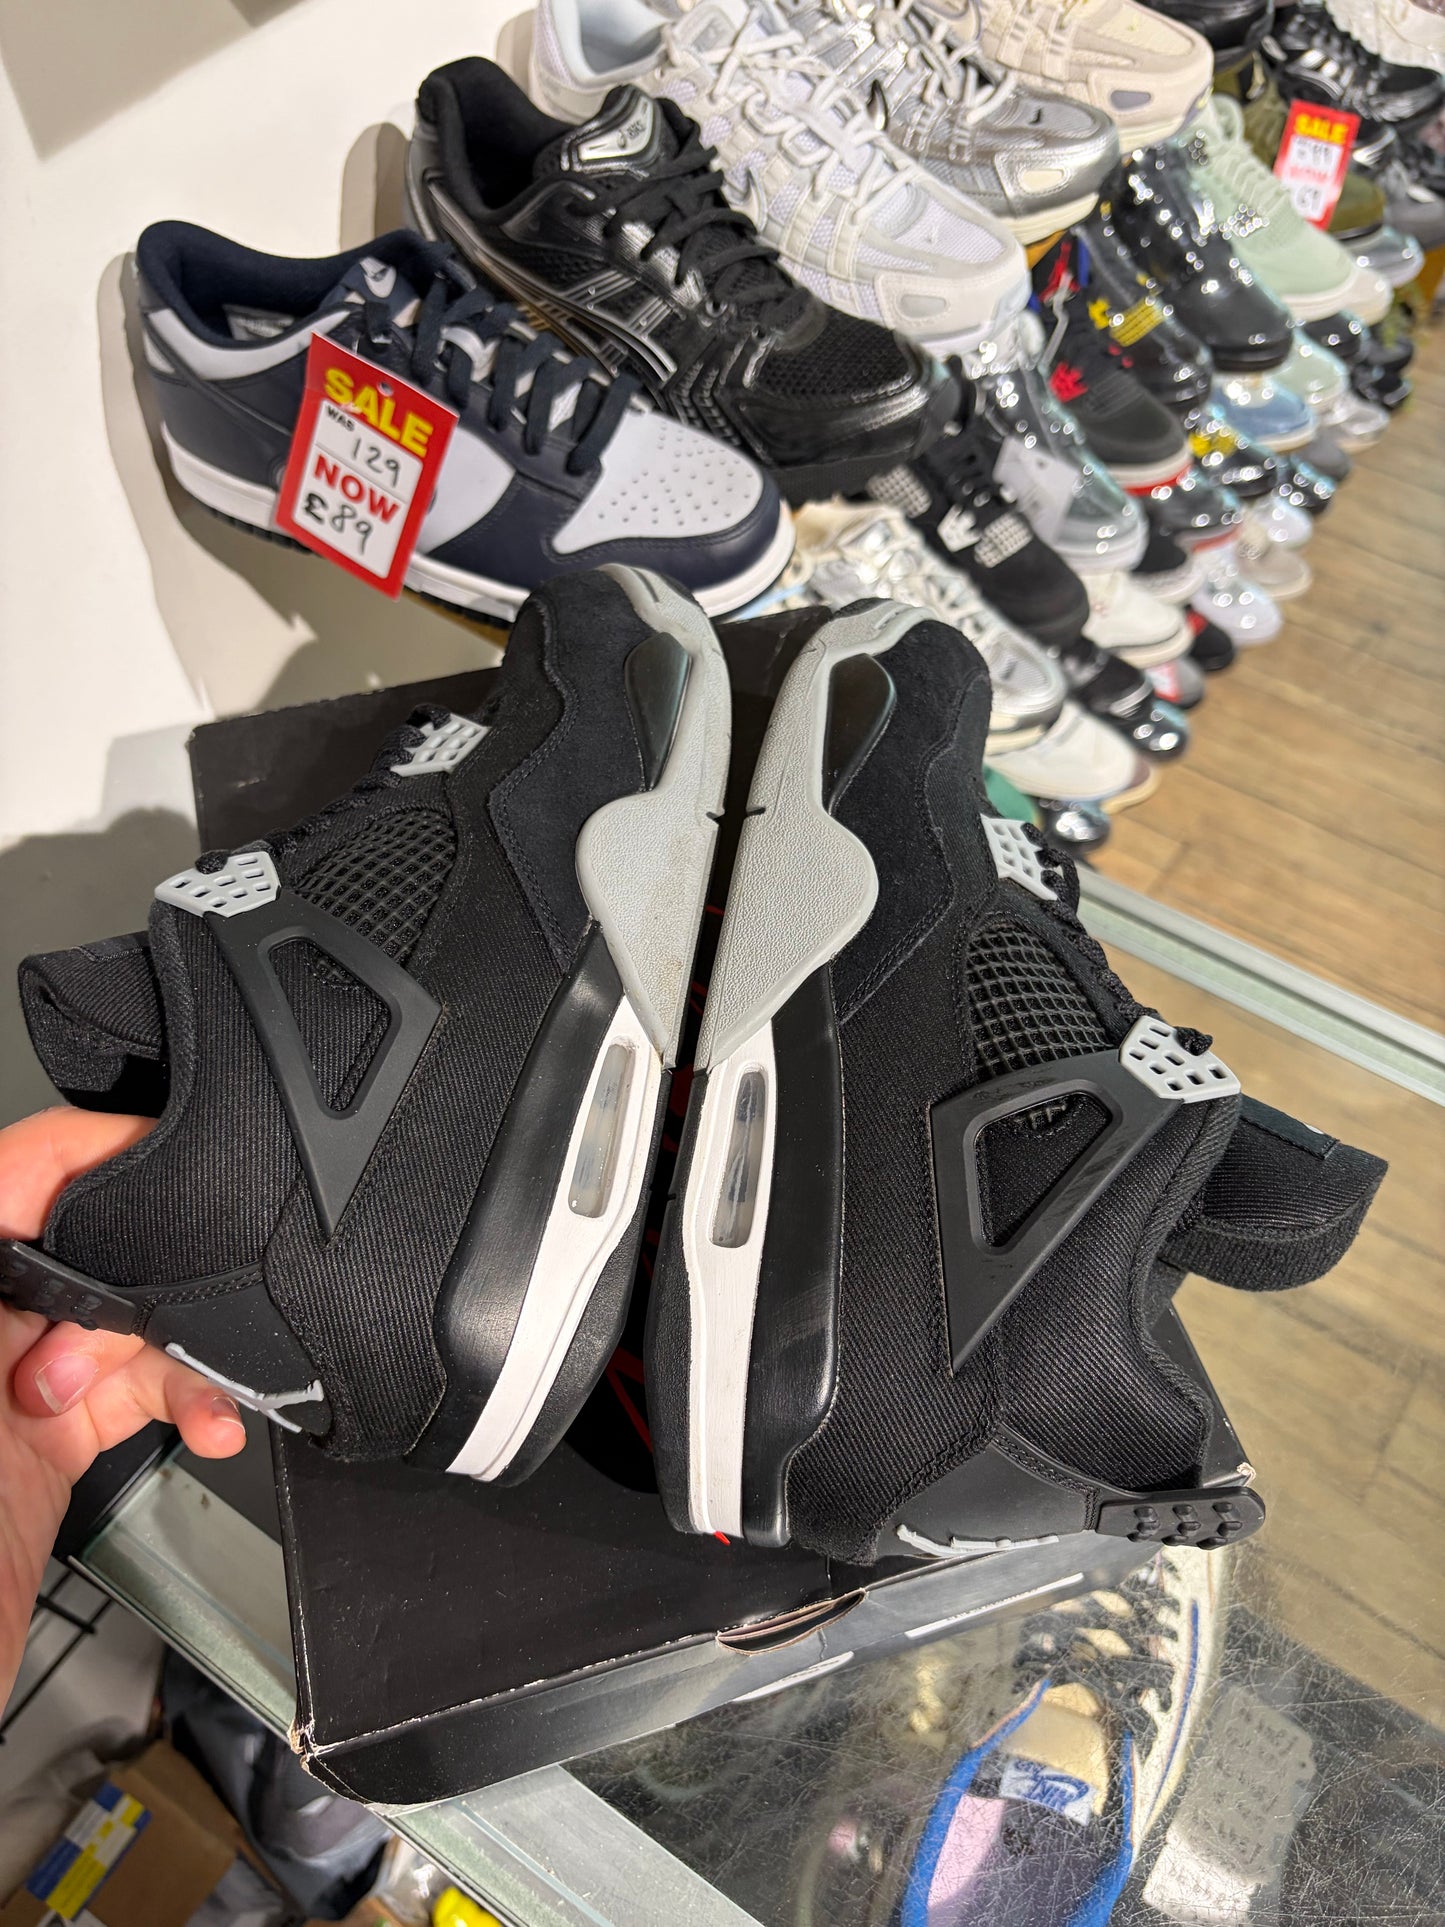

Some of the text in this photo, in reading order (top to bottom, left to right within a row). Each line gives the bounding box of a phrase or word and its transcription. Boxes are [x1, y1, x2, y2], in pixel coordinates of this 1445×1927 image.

[324, 367, 434, 458] SALE
[325, 405, 355, 432] WAS
[313, 453, 400, 525] NOW
[351, 437, 401, 488] 129
[302, 492, 374, 555] £89
